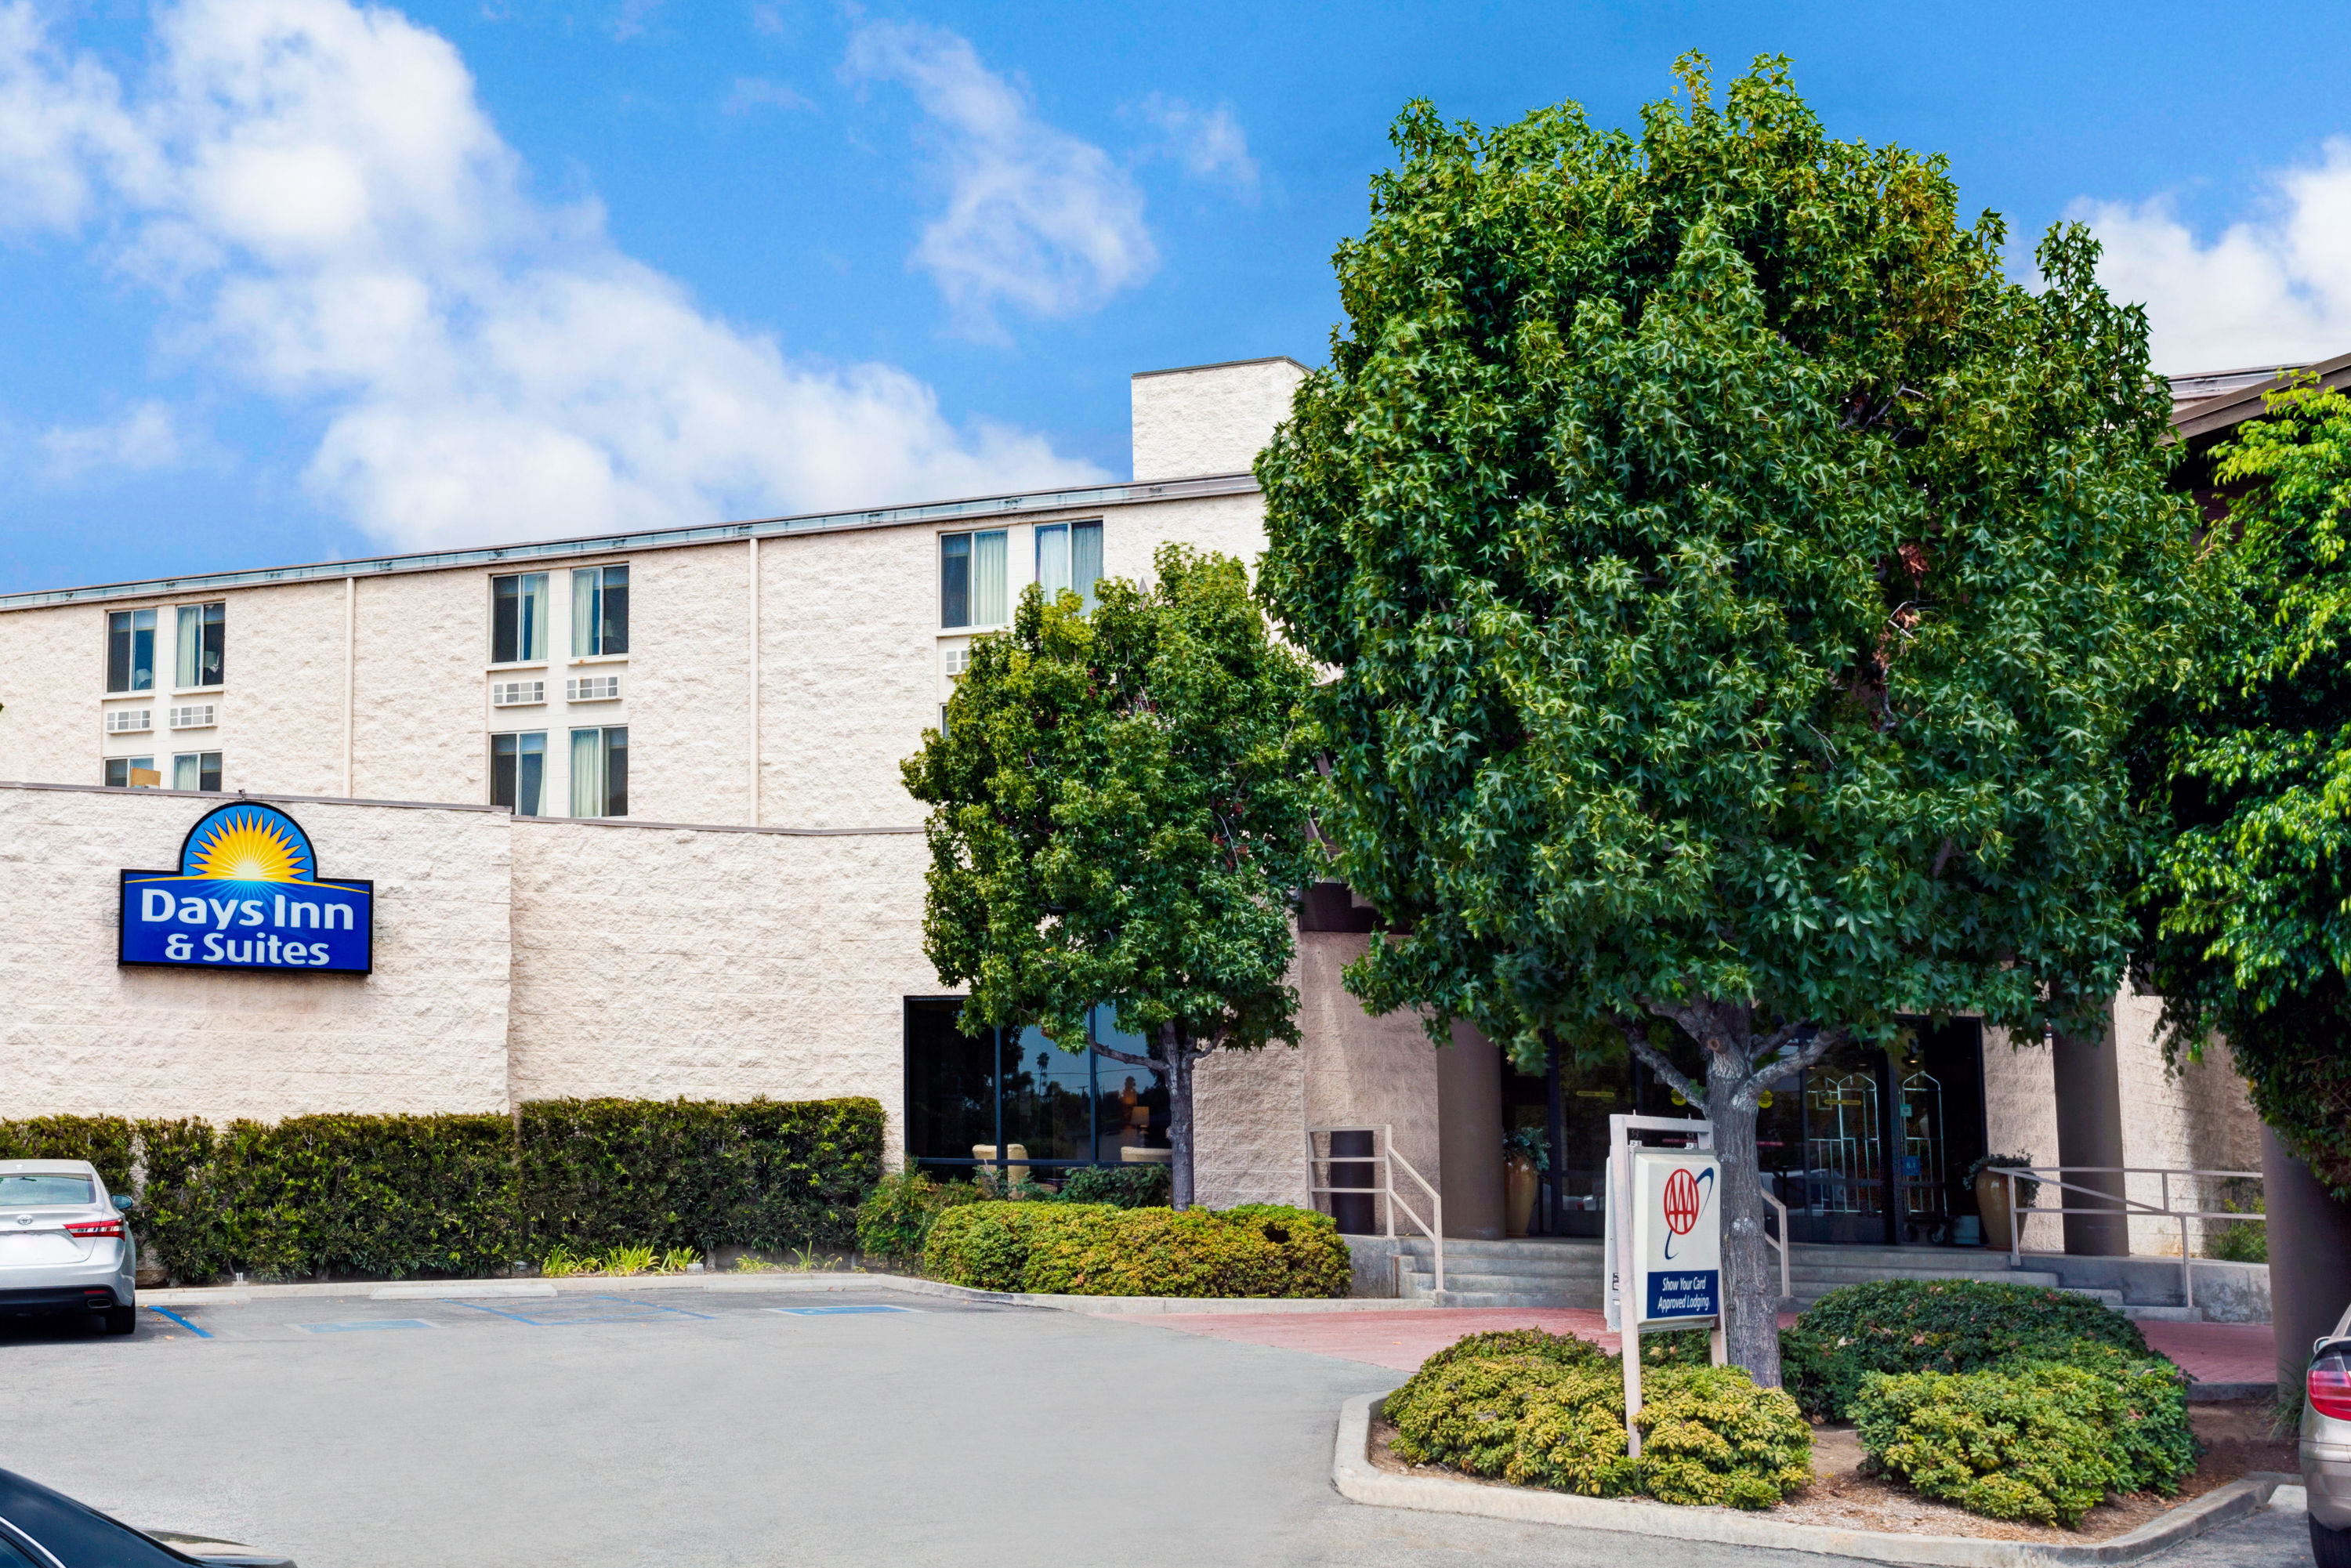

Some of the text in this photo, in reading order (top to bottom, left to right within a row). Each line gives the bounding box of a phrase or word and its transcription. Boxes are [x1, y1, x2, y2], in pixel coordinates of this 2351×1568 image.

[141, 888, 353, 930] Days Inn
[165, 932, 330, 965] & Suites
[1666, 1169, 1697, 1233] AAA
[1662, 1275, 1707, 1291] Show Your Card
[1657, 1294, 1686, 1313] Approved
